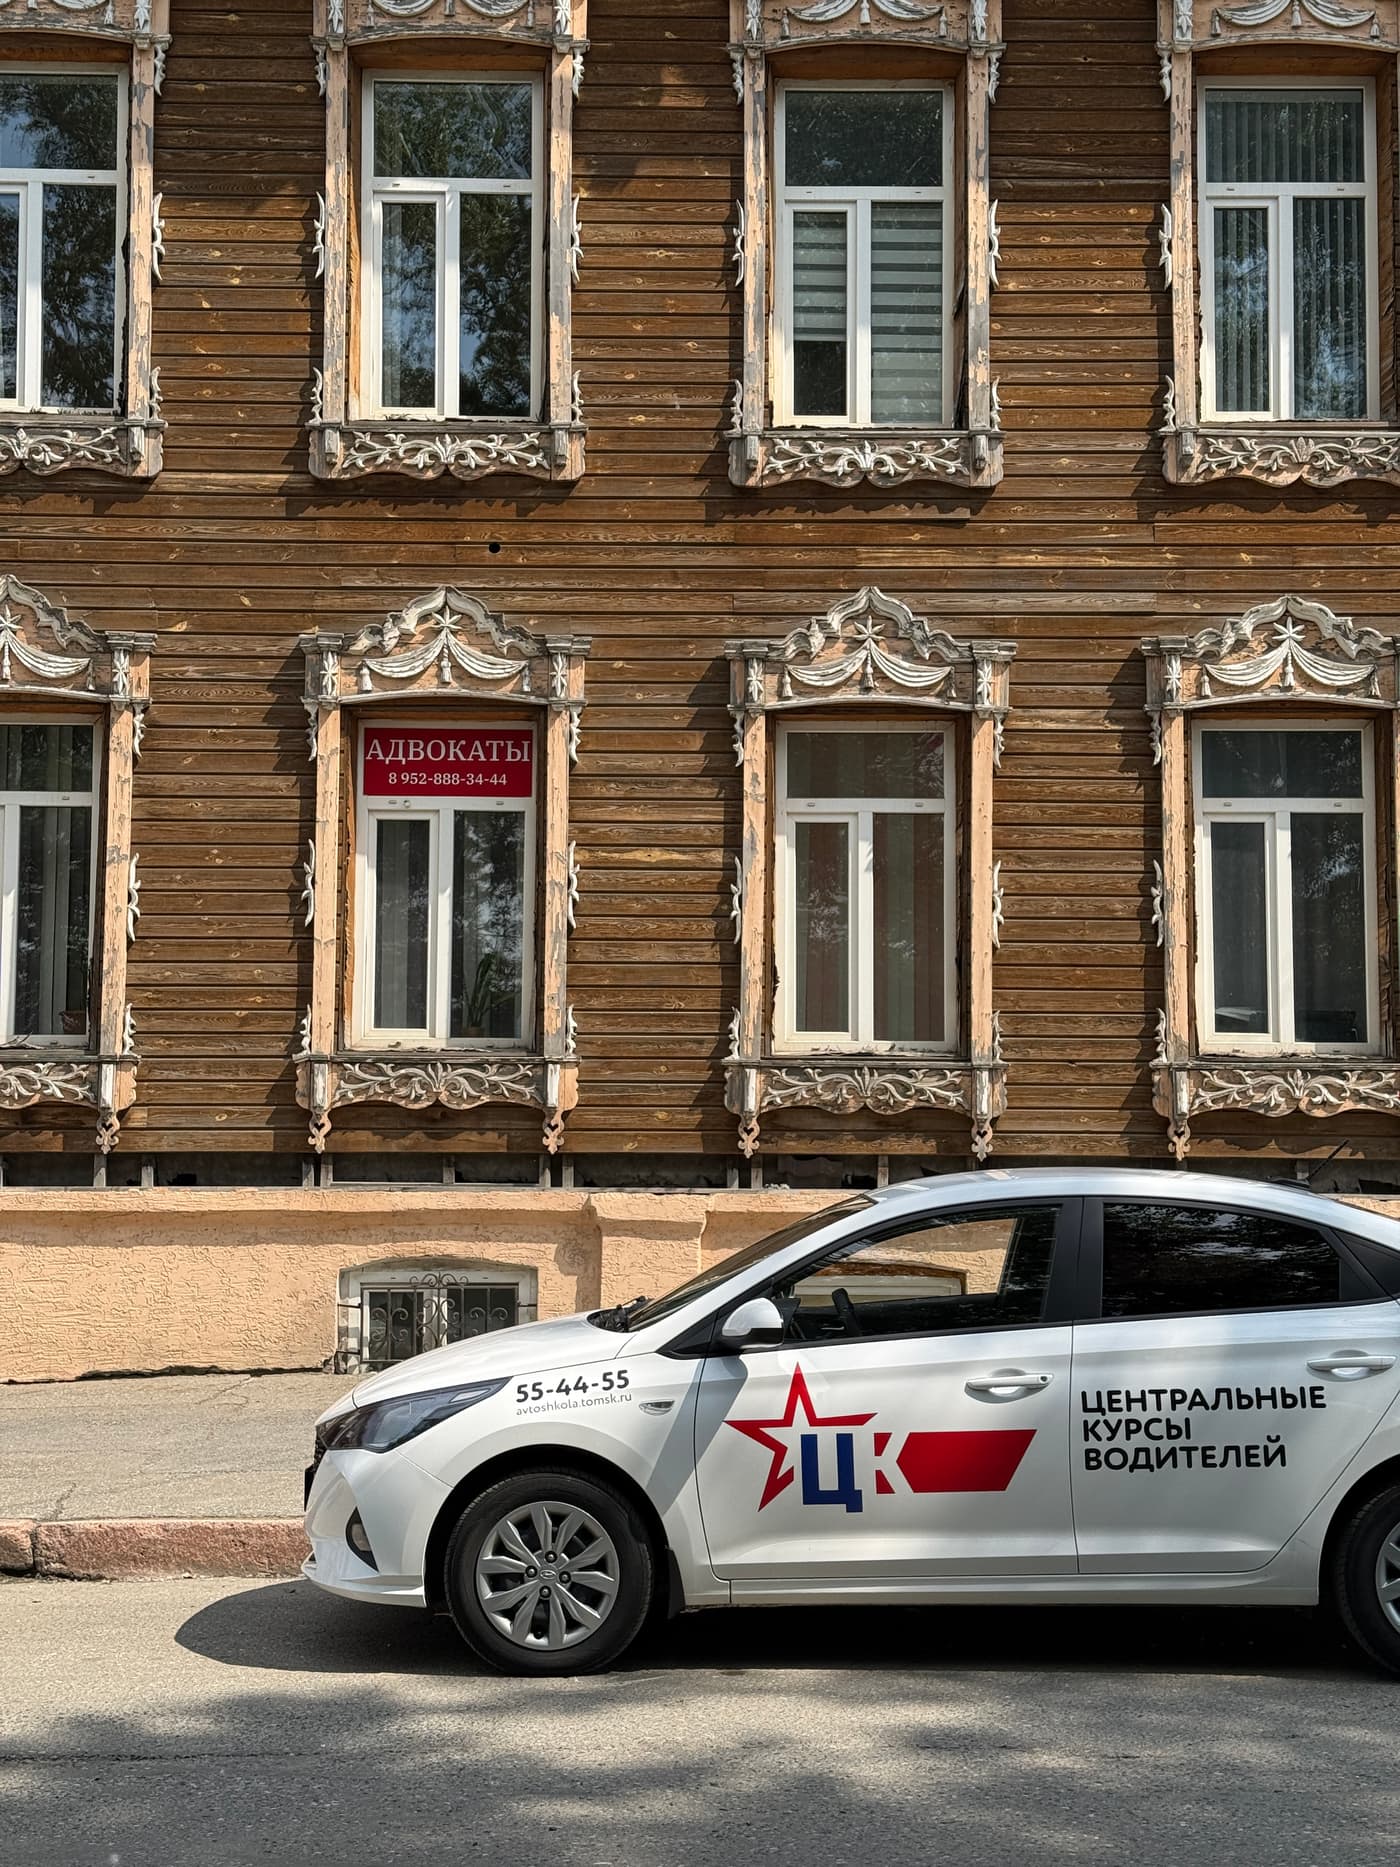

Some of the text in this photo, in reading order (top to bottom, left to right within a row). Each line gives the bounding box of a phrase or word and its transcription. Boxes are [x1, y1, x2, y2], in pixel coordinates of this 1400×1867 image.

[366, 739, 530, 765] АДВОКАТЫ
[388, 772, 507, 785] 8 952-888-34-44
[516, 1369, 630, 1403] 55-44-55
[516, 1392, 632, 1416] avtoshkola.tomsk.ru
[1081, 1386, 1327, 1416] ЦЕНТРАЛЬНЫЕ
[1083, 1417, 1191, 1442] КУРСЫ
[1084, 1435, 1287, 1472] ВОДИТЕЛЕЙ
